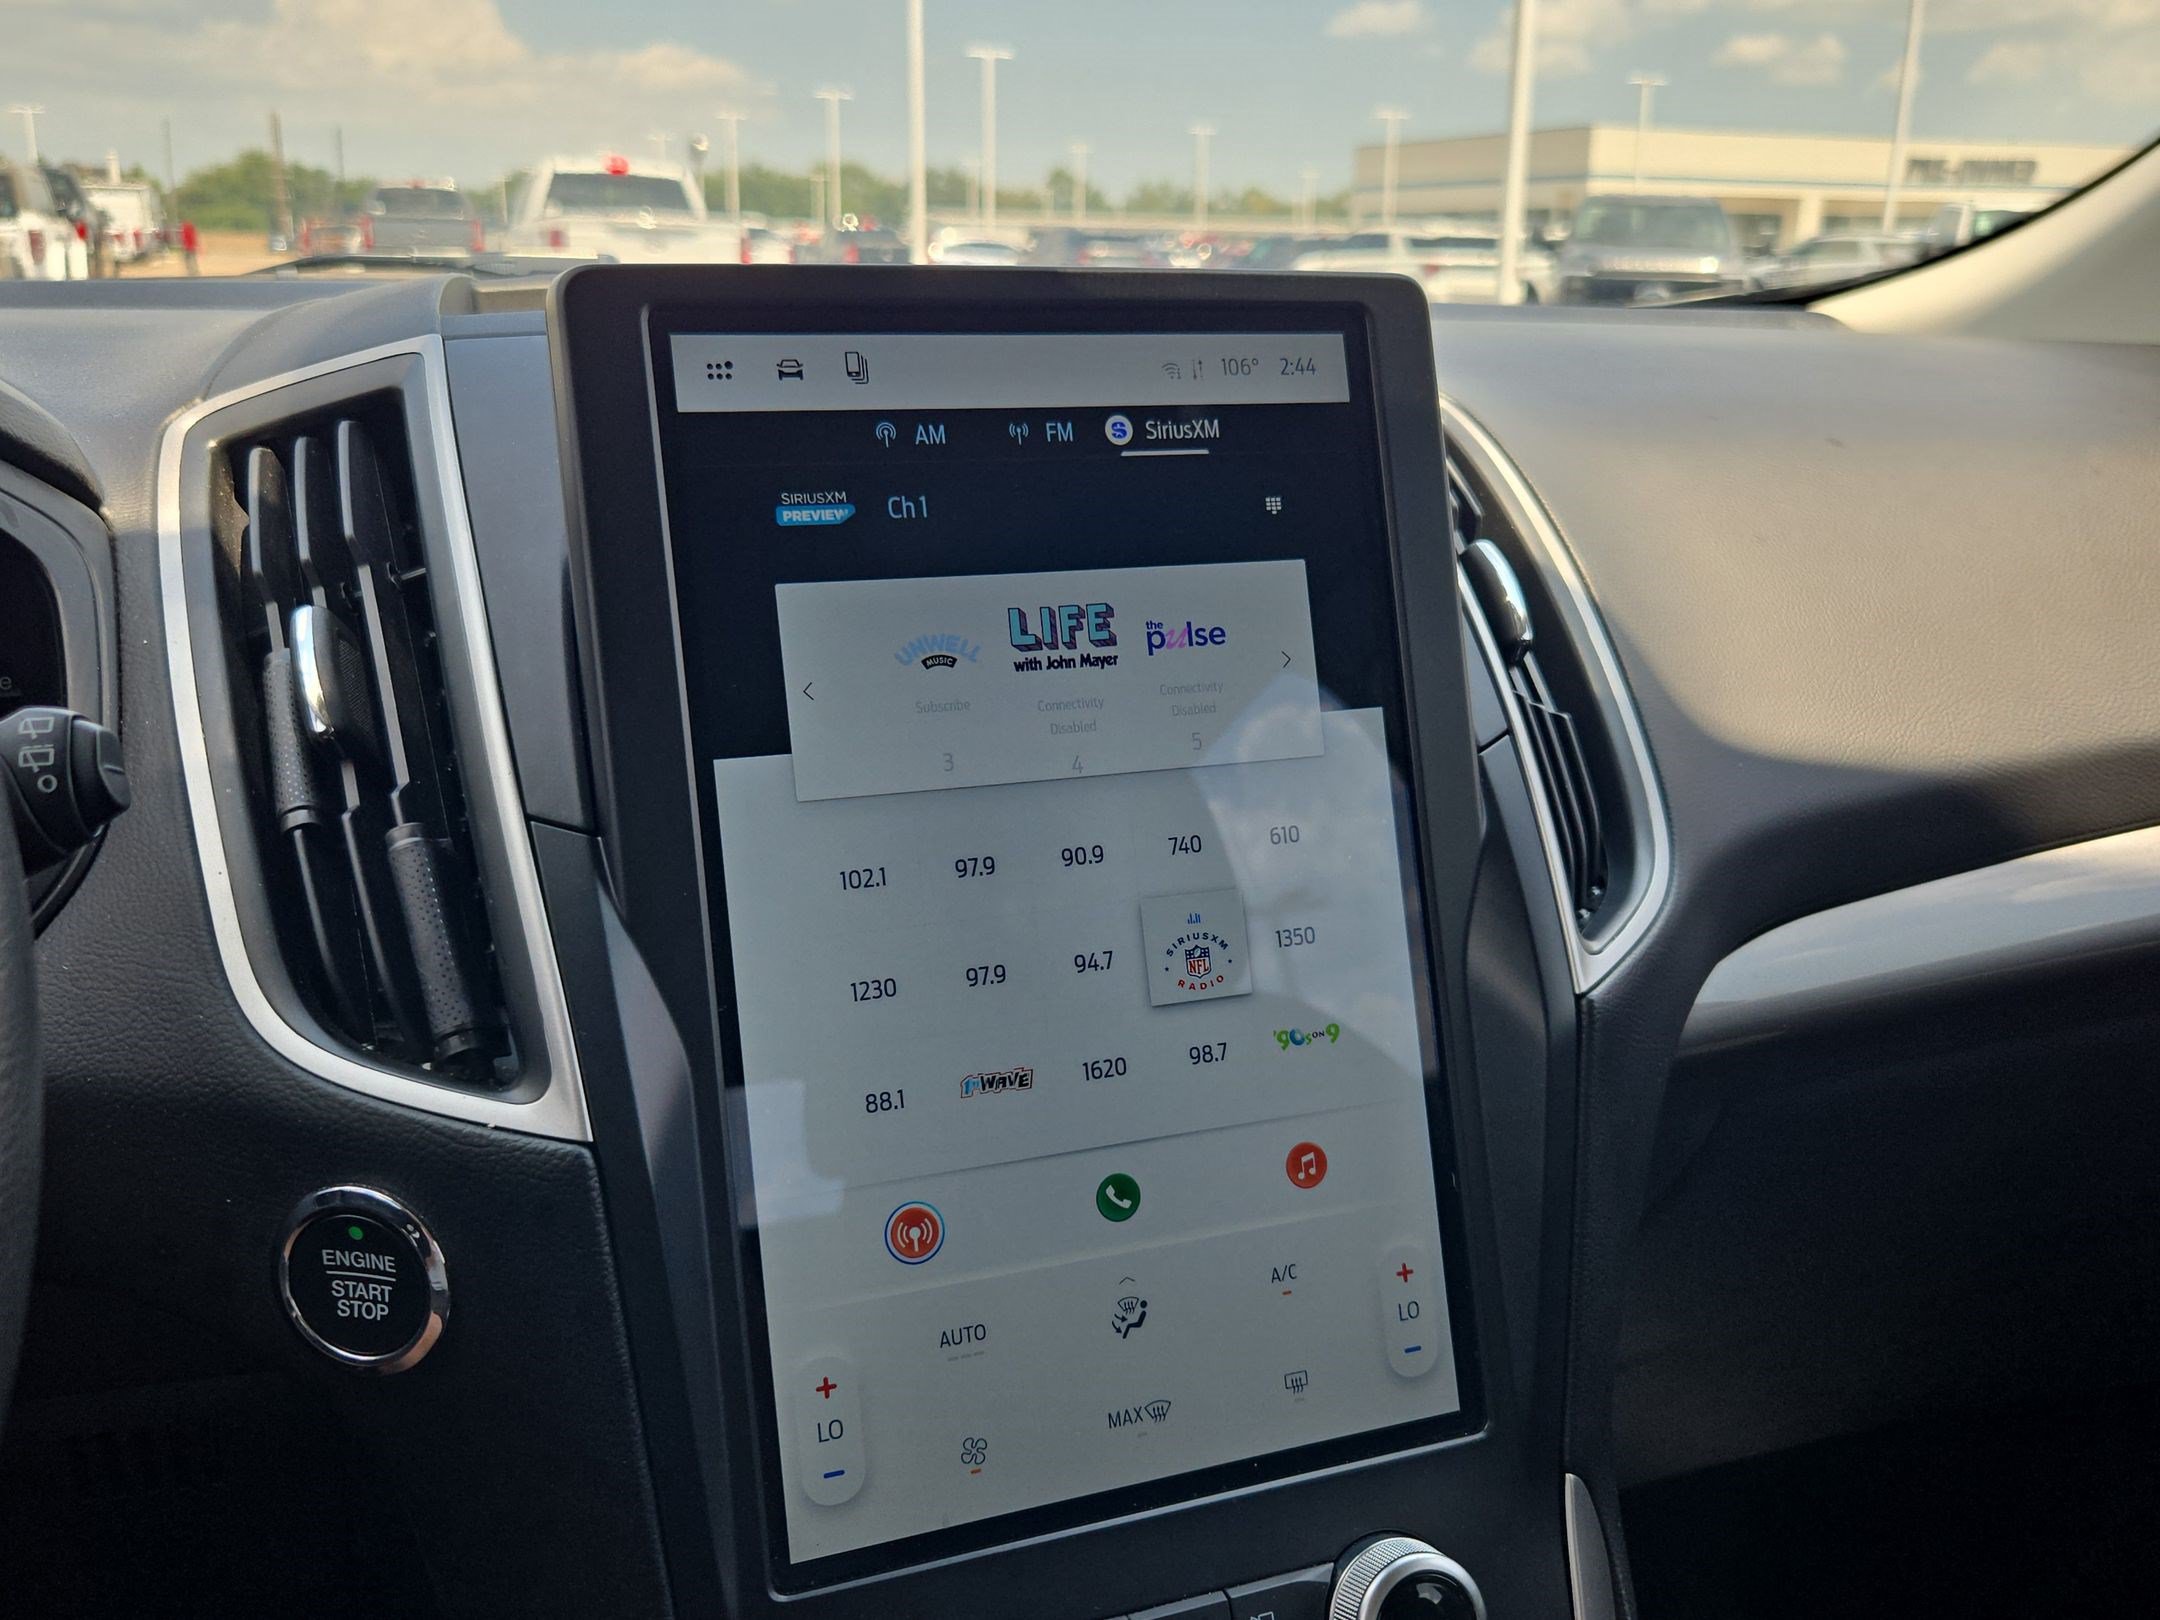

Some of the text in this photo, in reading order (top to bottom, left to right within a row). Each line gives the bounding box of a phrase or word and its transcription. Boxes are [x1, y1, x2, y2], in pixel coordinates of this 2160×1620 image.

[1279, 357, 1317, 376] 2:44
[915, 424, 946, 446] AM
[1046, 422, 1074, 443] FM
[1145, 418, 1220, 440] SiriusXM
[781, 491, 847, 504] SIRIUSXM
[888, 495, 928, 519] Ch 1
[1007, 602, 1118, 652] LIFE
[1145, 620, 1163, 630] the
[1146, 621, 1226, 656] pulse
[926, 656, 954, 667] MUSIC
[1014, 652, 1118, 672] with John Mayer
[1160, 680, 1224, 696] Connectivity
[915, 699, 971, 714] Subscribe
[1037, 697, 1104, 713] Connectivity
[1171, 702, 1217, 717] Disabled
[1050, 720, 1097, 736] Disabled
[1192, 732, 1201, 750] 5
[943, 753, 954, 772] 3
[1072, 755, 1083, 774] 4
[1168, 835, 1202, 856] 740
[1270, 825, 1300, 845] 610
[1061, 844, 1105, 867] 90.9
[955, 856, 996, 878] 97.9
[839, 867, 887, 890] 102.1
[1166, 932, 1229, 957] SIRIUSXM
[1275, 926, 1316, 948] 1350
[1074, 951, 1113, 973] 94.7
[1188, 959, 1210, 975] NFL
[966, 965, 1007, 987] 97.9
[1178, 975, 1224, 990] RADIO
[850, 978, 897, 1002] 1230
[1326, 1023, 1340, 1043] 9
[1189, 1042, 1228, 1064] 98.7
[1082, 1057, 1127, 1081] 1620
[980, 1071, 1030, 1091] WAVE
[865, 1090, 905, 1113] 88.1
[322, 1249, 396, 1273] ENGINE
[1270, 1264, 1298, 1284] A/C
[331, 1280, 393, 1303] START
[337, 1299, 389, 1321] STOP
[1397, 1301, 1420, 1321] LO
[939, 1323, 987, 1349] AUTO
[1107, 1407, 1144, 1429] MAX
[816, 1419, 844, 1443] LO
